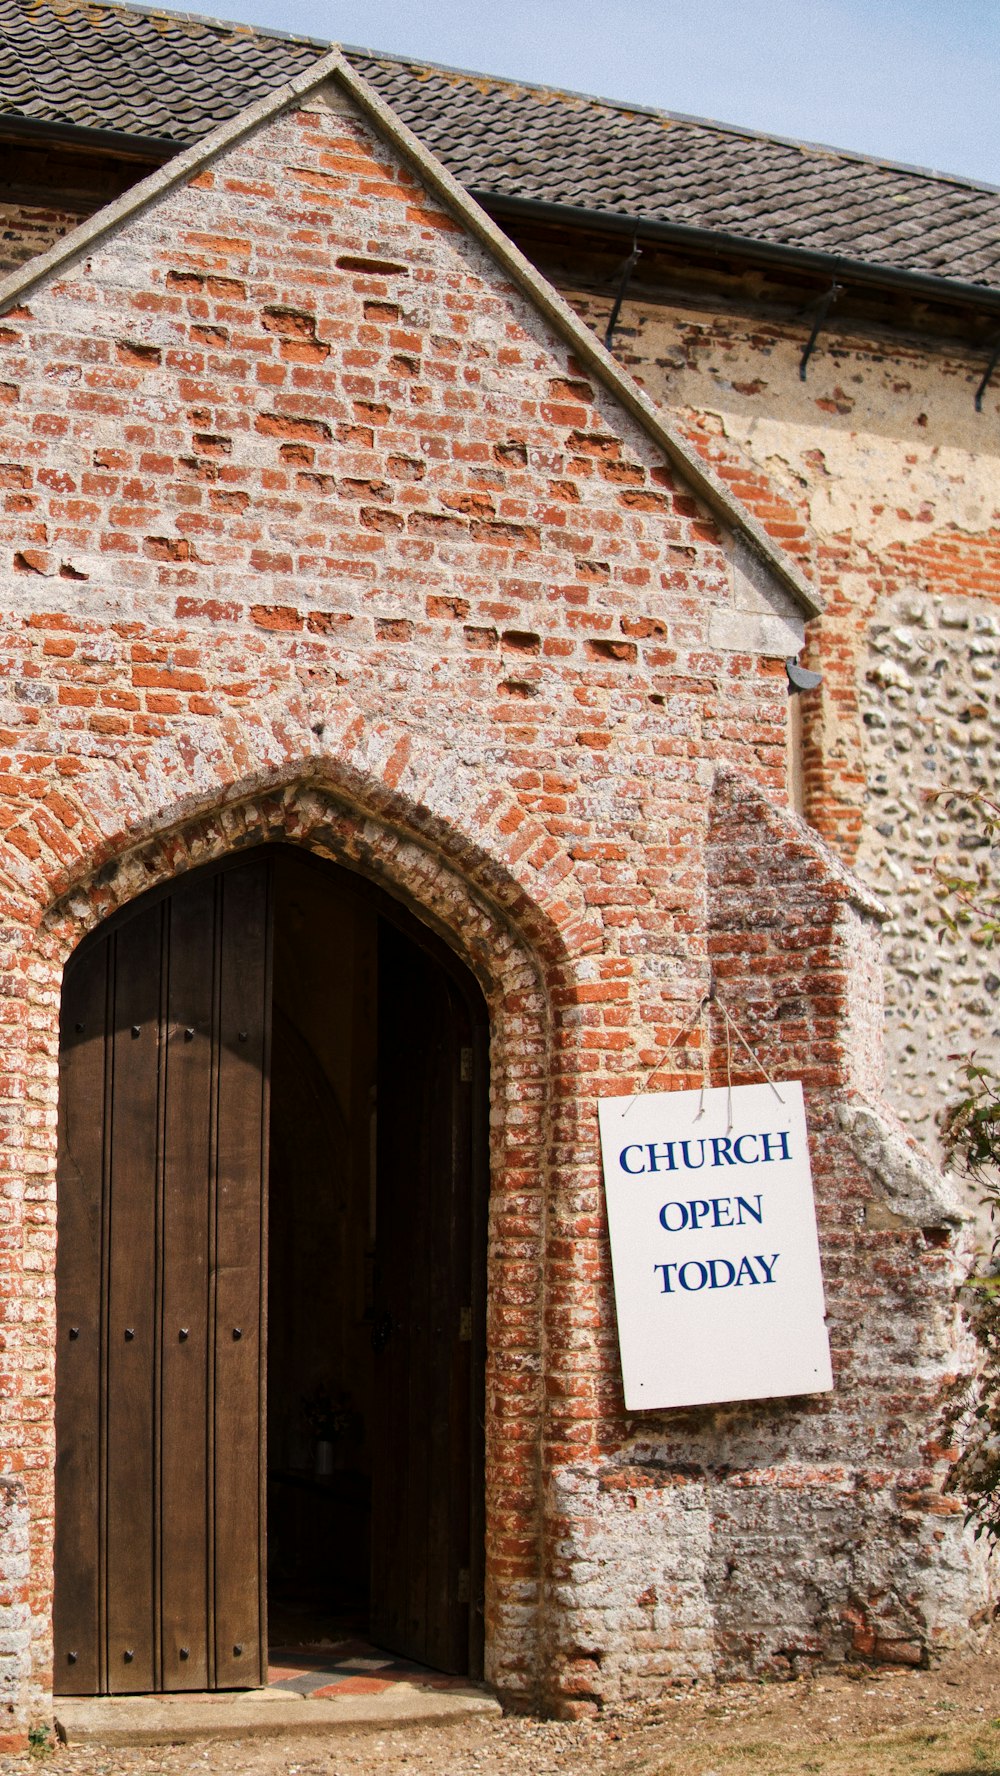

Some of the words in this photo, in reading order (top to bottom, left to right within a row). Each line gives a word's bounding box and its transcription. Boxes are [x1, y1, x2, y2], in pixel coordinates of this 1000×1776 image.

[619, 1131, 793, 1175] CHURCH
[659, 1194, 763, 1232] OPEN
[653, 1253, 780, 1294] TODAY
